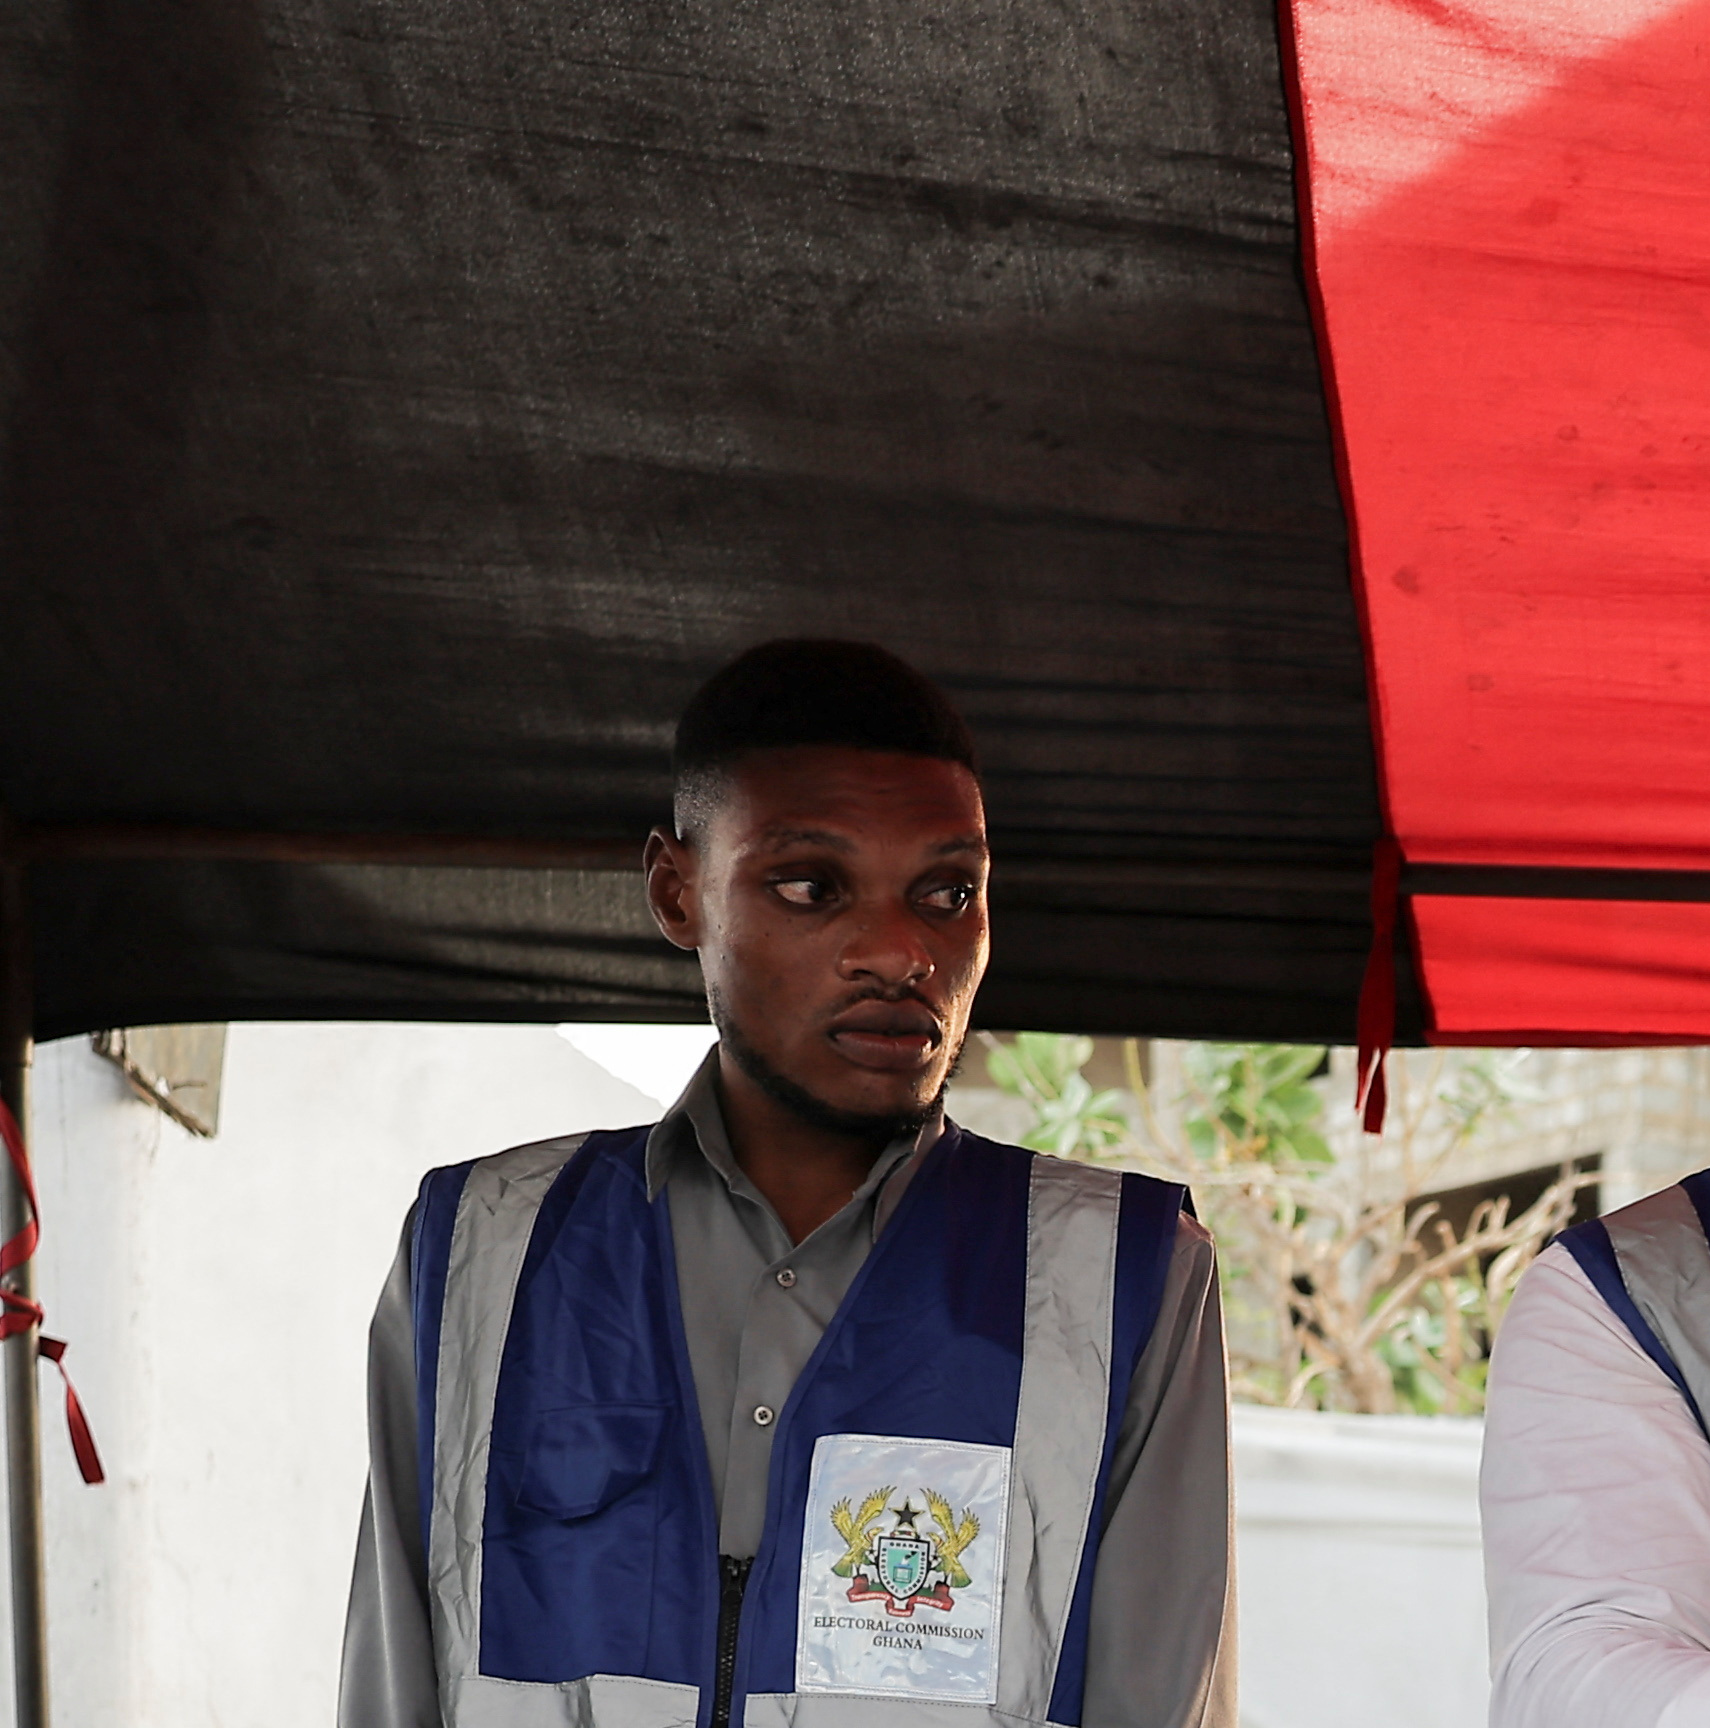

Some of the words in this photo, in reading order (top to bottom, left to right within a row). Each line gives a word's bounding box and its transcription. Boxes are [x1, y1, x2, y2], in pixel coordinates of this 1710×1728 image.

[814, 1616, 892, 1632] ELECTORAL
[896, 1622, 984, 1640] COMMISSION
[872, 1636, 923, 1650] GHANA
